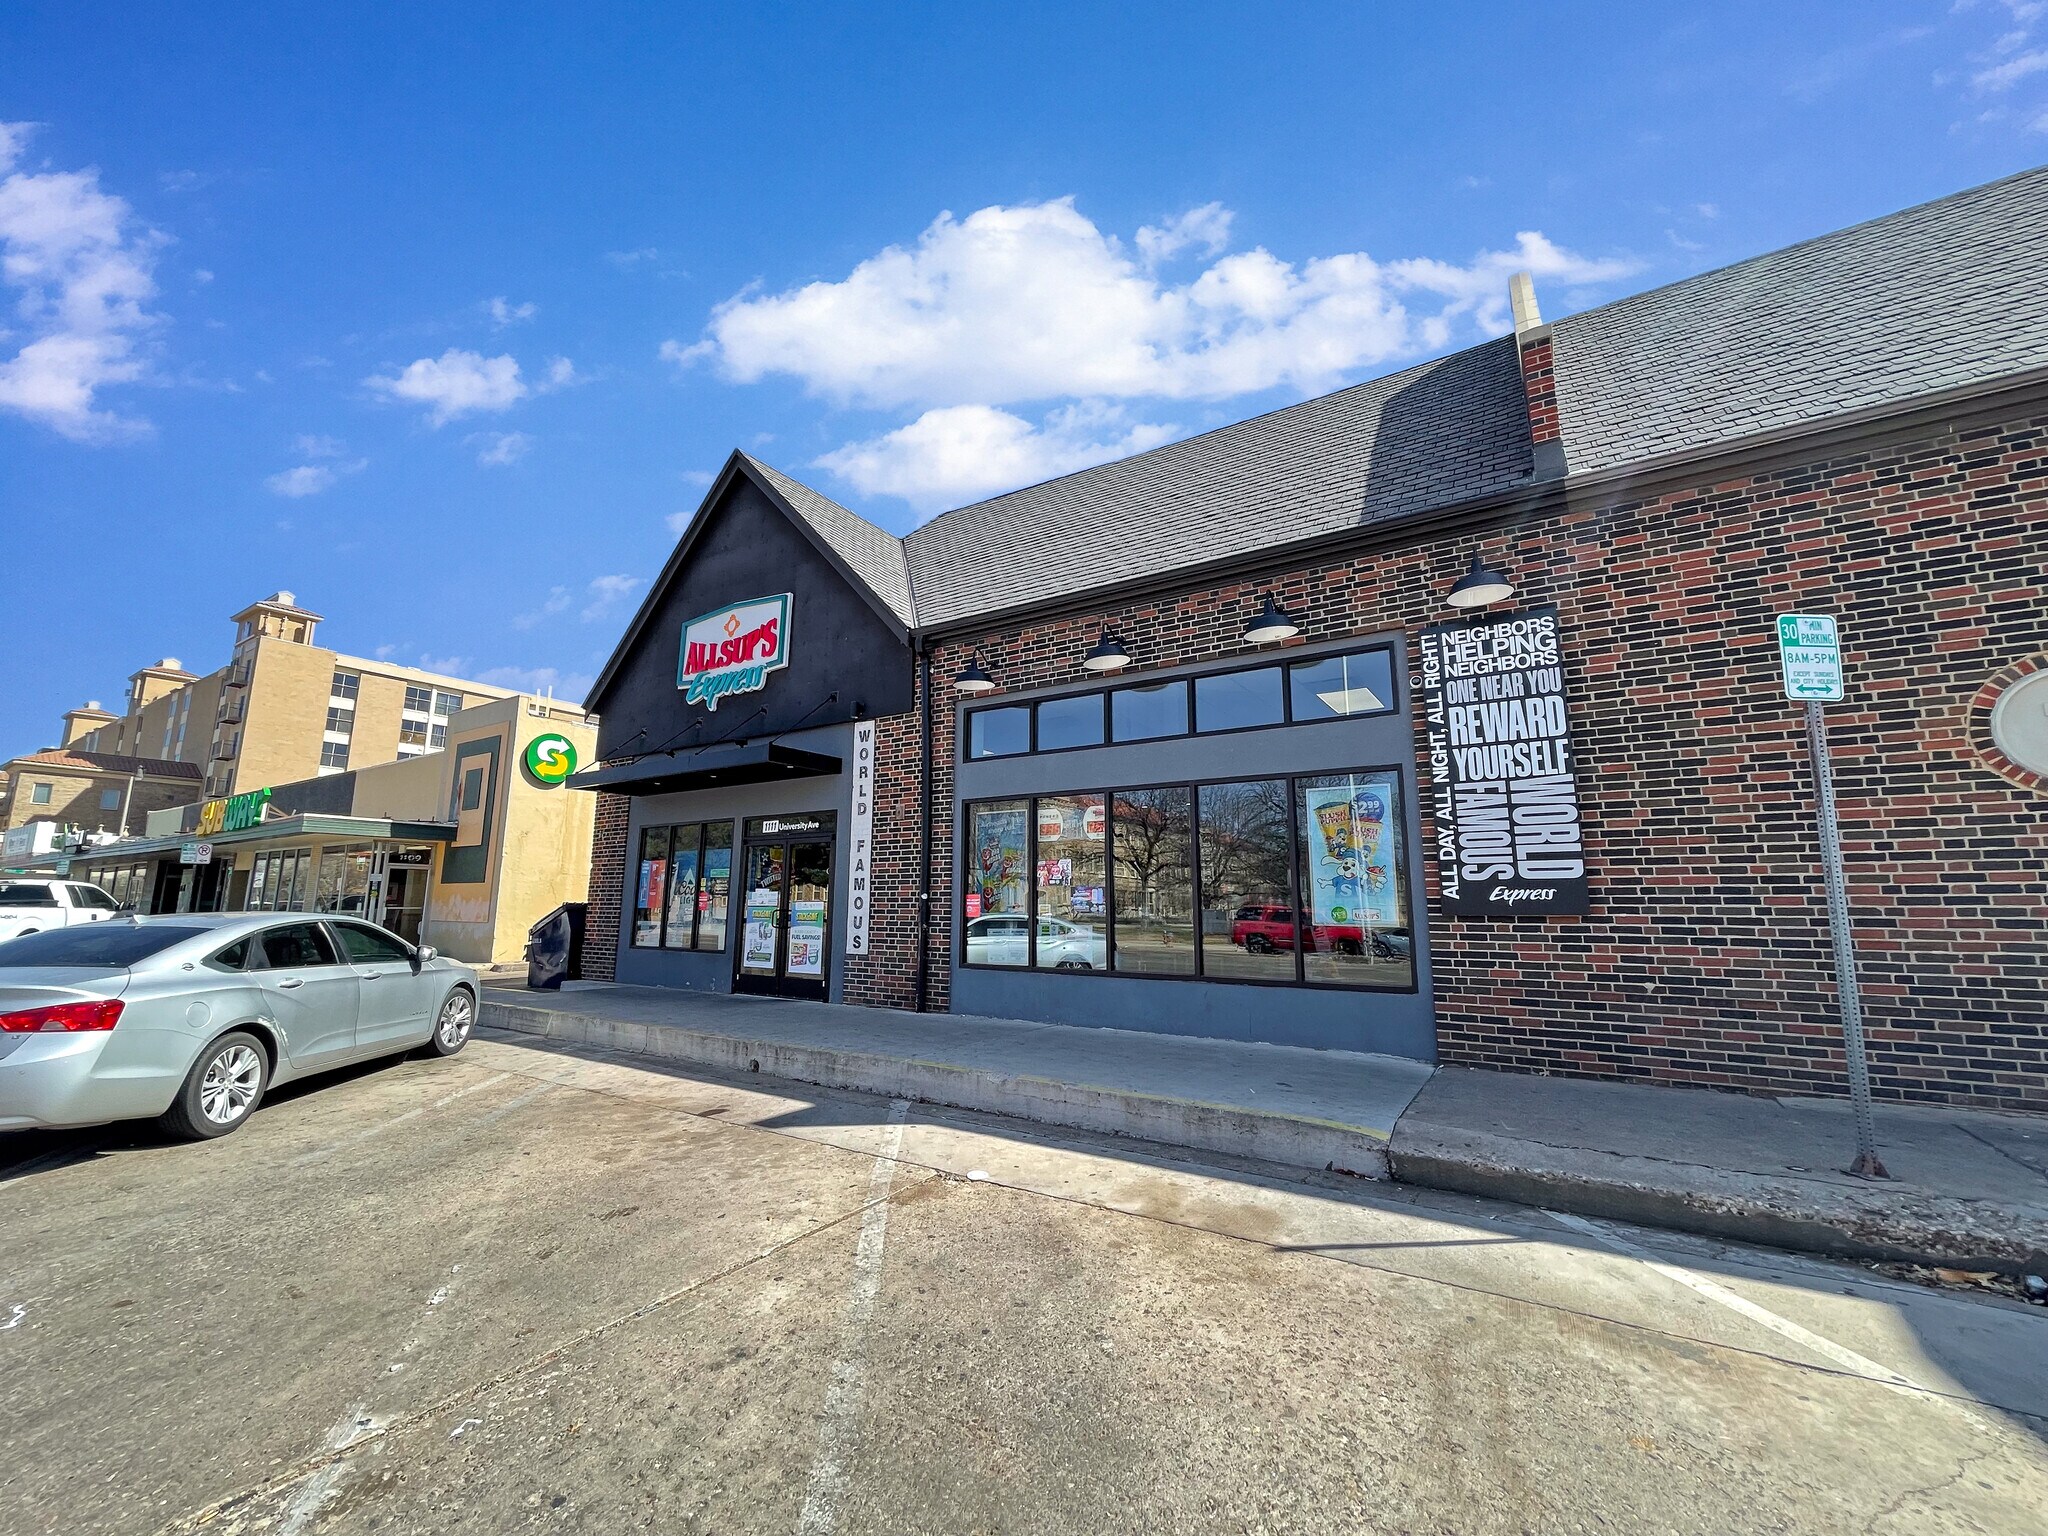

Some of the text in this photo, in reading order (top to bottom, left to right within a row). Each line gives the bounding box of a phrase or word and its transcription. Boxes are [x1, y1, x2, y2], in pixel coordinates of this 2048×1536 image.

[684, 618, 777, 675] ALLSUP'S
[1441, 616, 1555, 646] NEIGHBORS
[1443, 631, 1557, 663] HELPING
[1782, 624, 1797, 639] 30
[1801, 633, 1833, 644] PARKING
[1444, 650, 1559, 678] NEIGHBORS
[1787, 652, 1836, 664] 8AM-5PM
[686, 665, 767, 709] Express
[1446, 667, 1562, 704] ONE NEAR YOU
[1448, 695, 1567, 746] REWARD
[1420, 634, 1460, 899] ALL DAY, ALL NIGHT, ALL RIGHT!
[1452, 739, 1569, 781] YOURSELF
[195, 787, 272, 837] SUBWAY
[764, 821, 820, 832] 1111 University Ave
[1454, 780, 1515, 881] FAMOUS
[1509, 773, 1584, 880] WORLD
[852, 729, 871, 949] WORLD FAMOUS
[1489, 886, 1557, 906] Express
